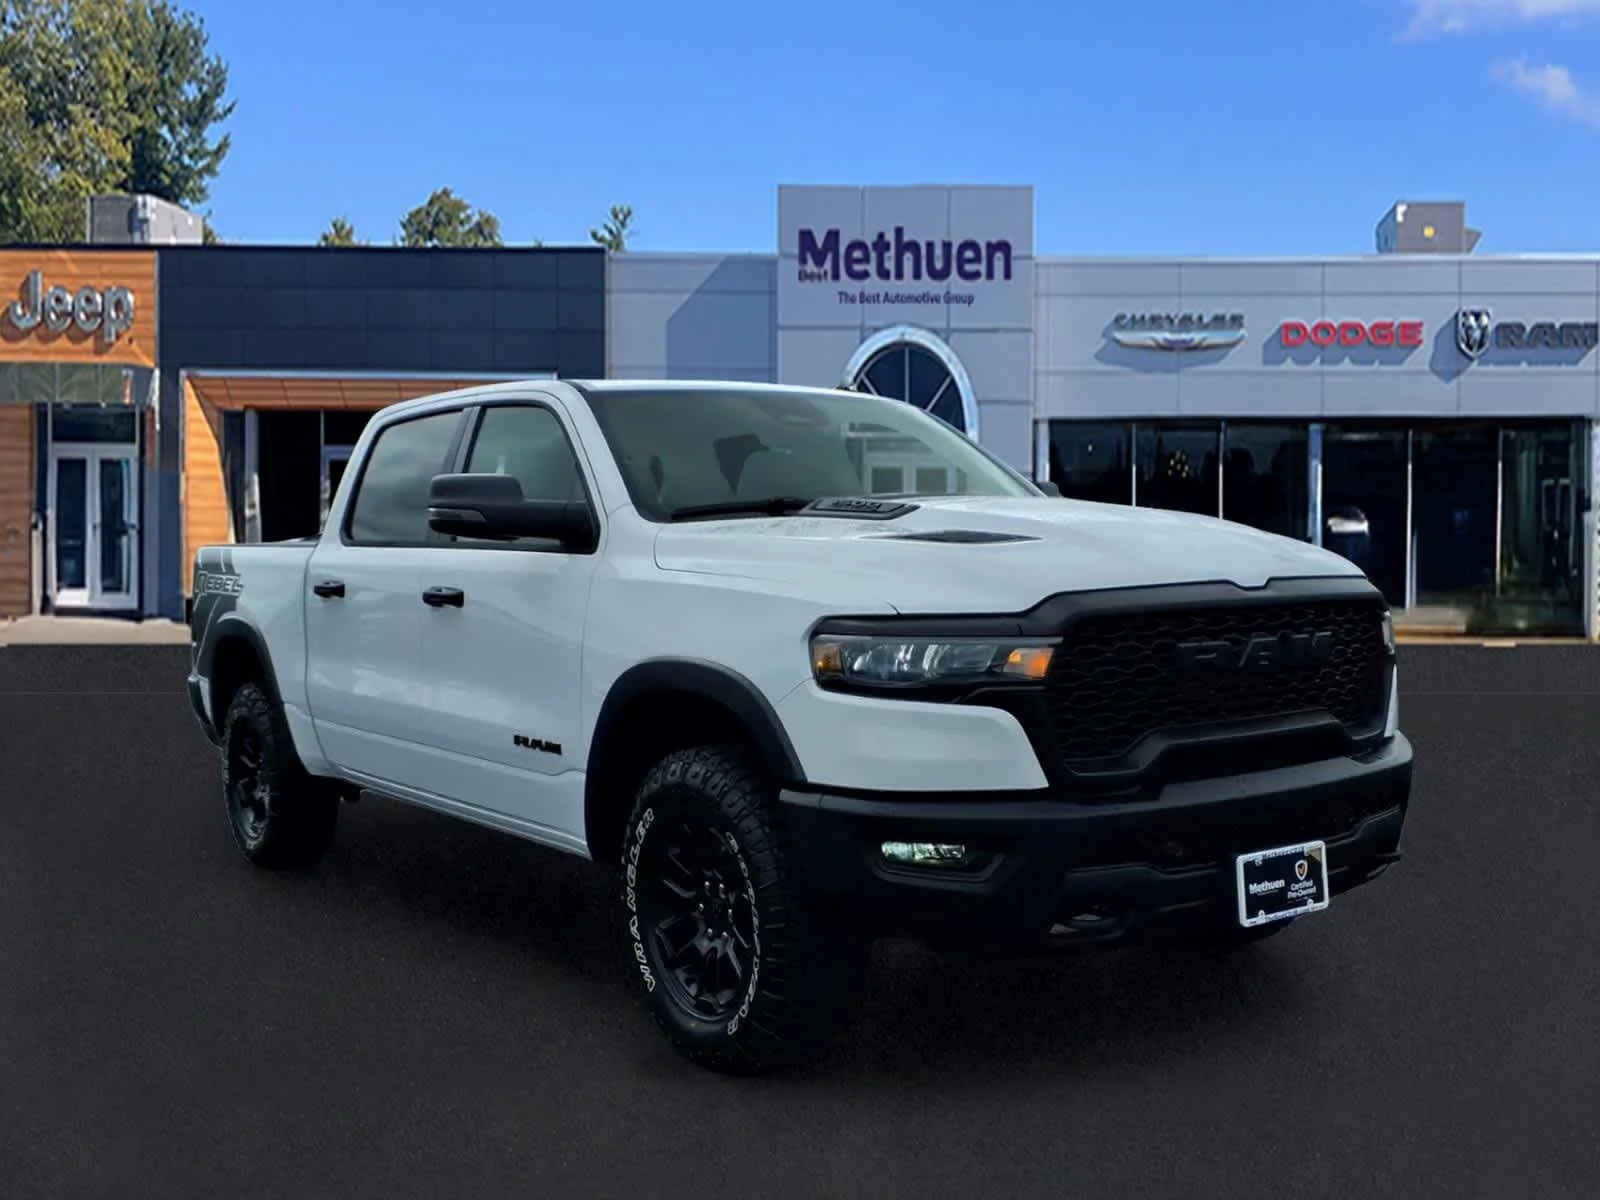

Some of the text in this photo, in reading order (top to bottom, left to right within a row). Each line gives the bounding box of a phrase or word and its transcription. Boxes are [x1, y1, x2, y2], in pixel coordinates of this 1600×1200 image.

[798, 226, 1012, 282] Methuen
[798, 269, 829, 282] Best
[10, 269, 135, 342] Jeep
[838, 291, 975, 307] The Best Automotive Group
[1281, 321, 1424, 347] DODGE
[1495, 322, 1598, 349] RAM
[626, 807, 656, 993] WRANGLER
[1249, 879, 1285, 895] Methuen
